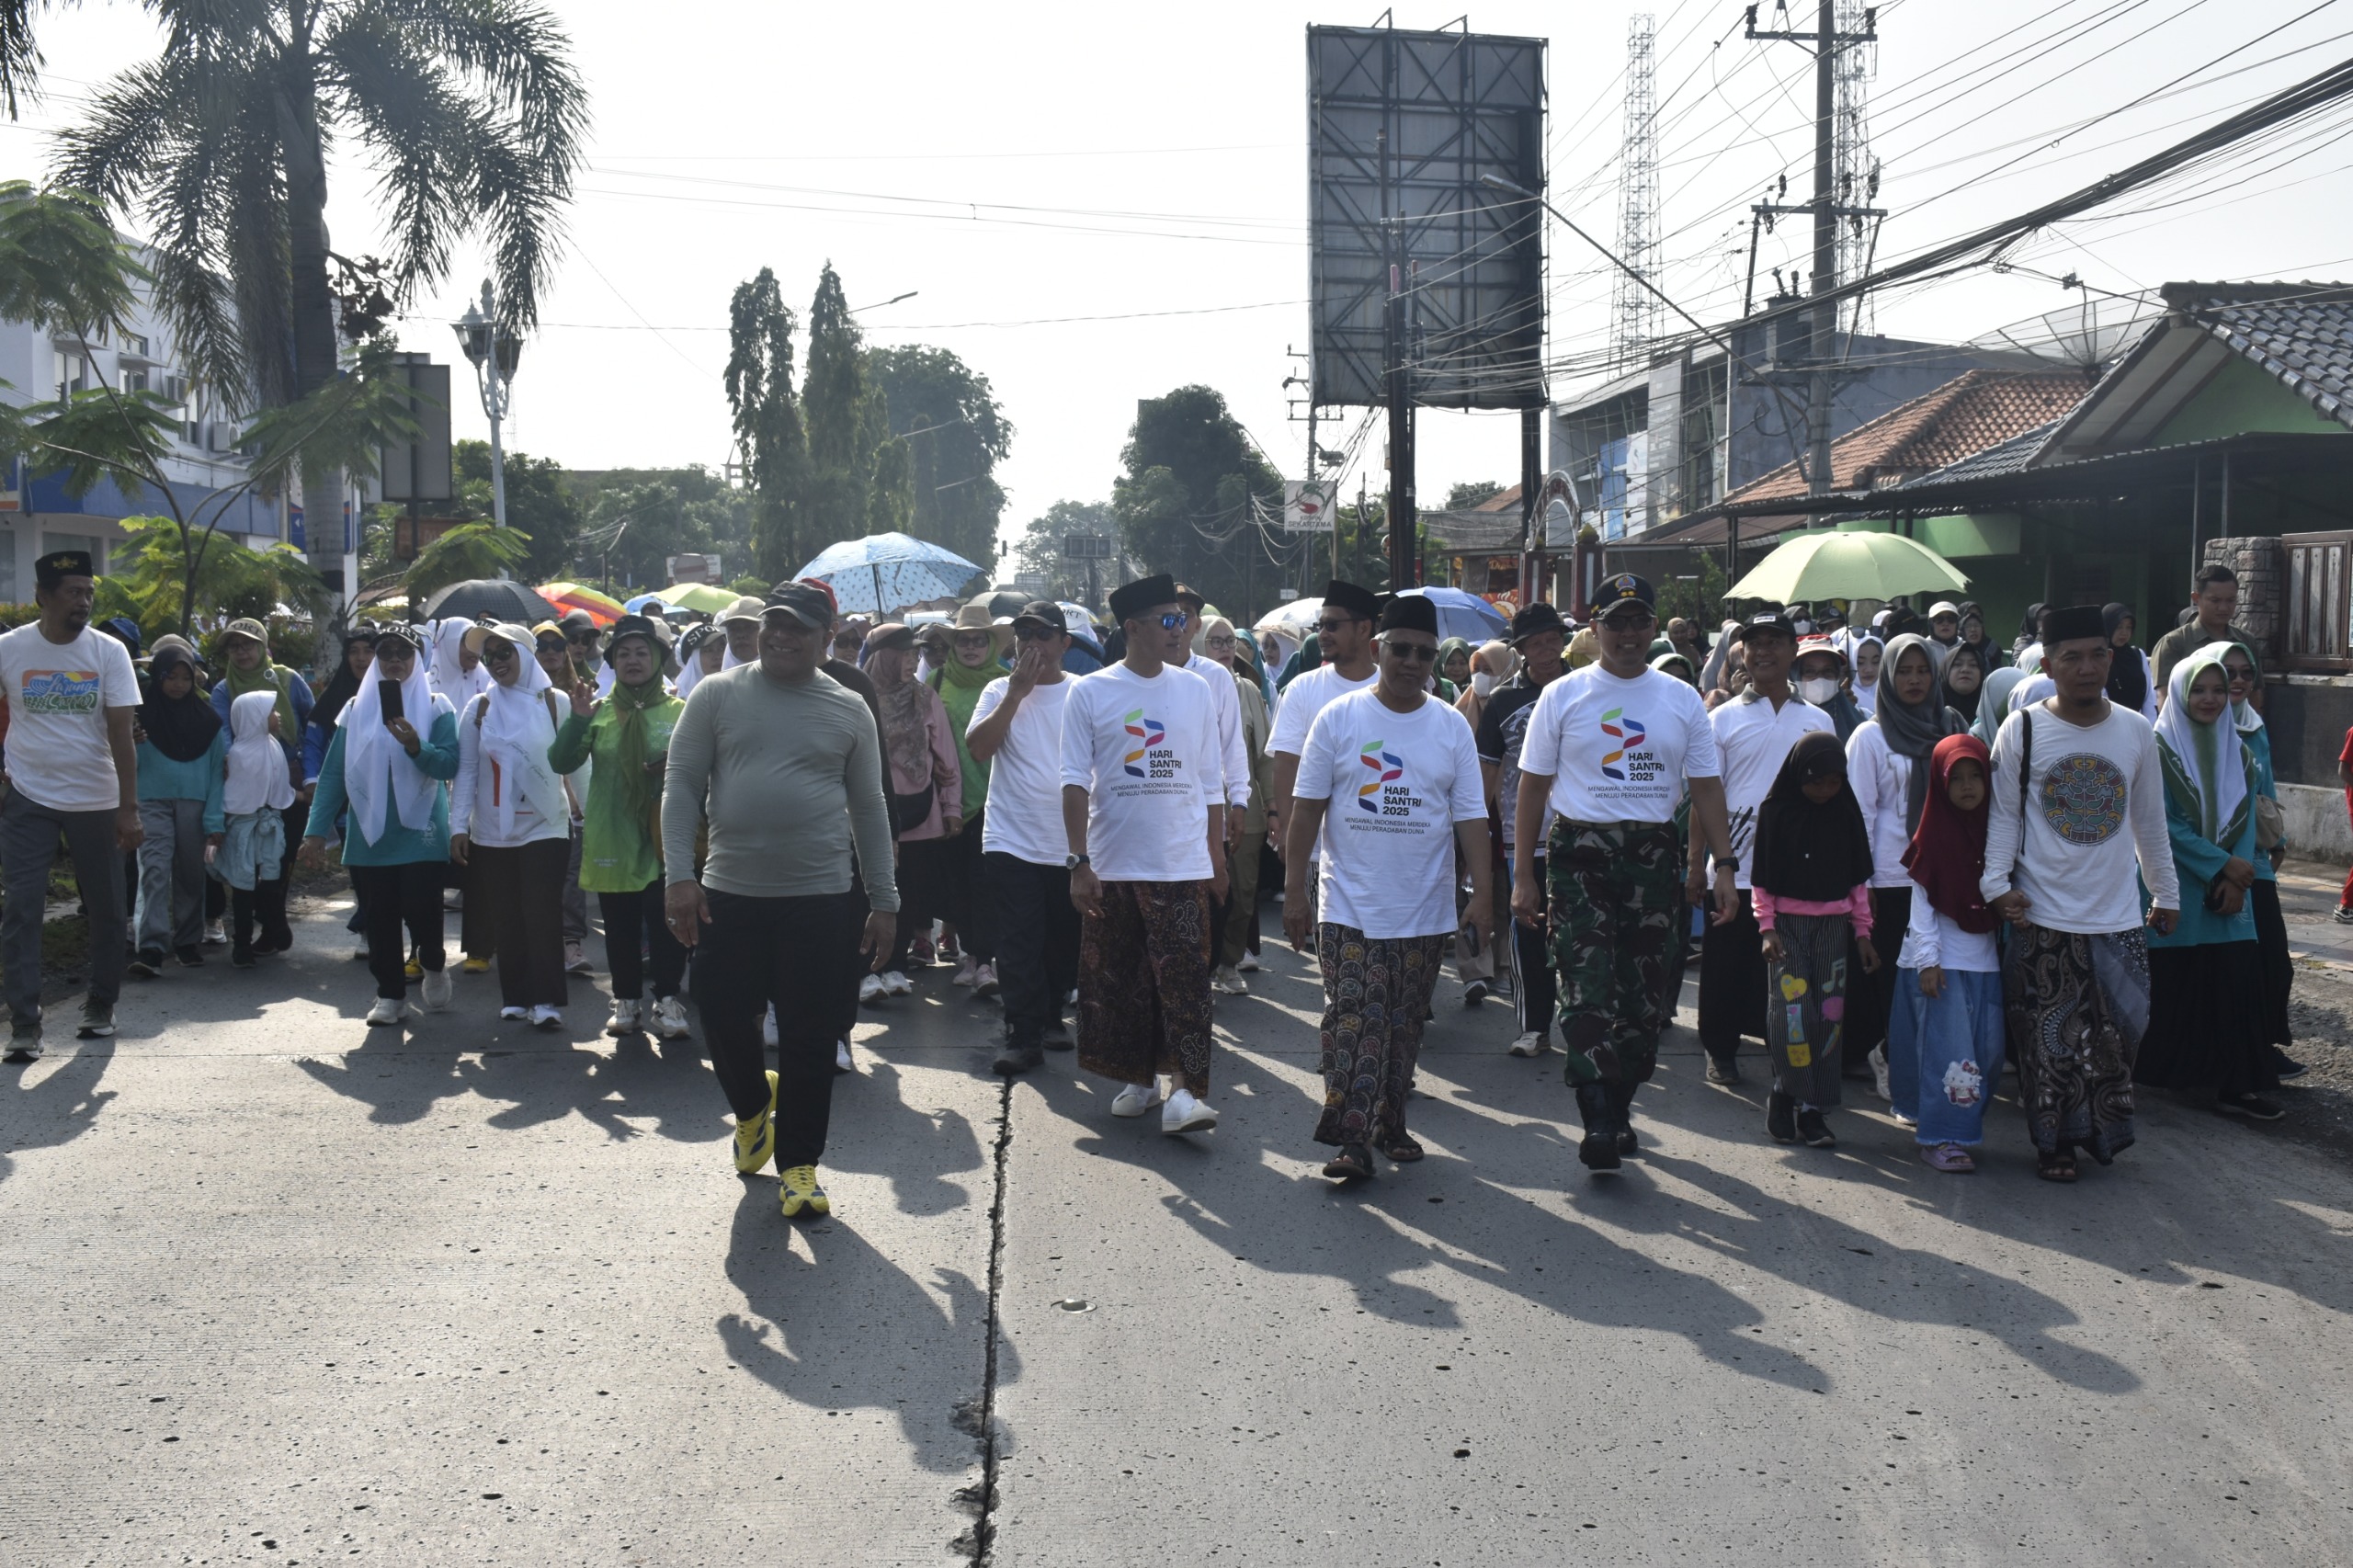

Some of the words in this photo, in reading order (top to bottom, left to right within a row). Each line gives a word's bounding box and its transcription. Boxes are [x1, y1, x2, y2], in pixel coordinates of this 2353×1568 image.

[1149, 750, 1173, 759] HARI
[1628, 753, 1654, 761] HARI
[1149, 759, 1182, 769] SANTRI
[1629, 762, 1665, 772] SANTRI
[1149, 769, 1174, 778] 2025
[1630, 772, 1654, 781] 2025
[1110, 783, 1142, 791] MENGAWAL
[1384, 786, 1410, 796] HARI
[1116, 790, 1140, 798] MENUJU
[1383, 796, 1422, 807] SANTRI
[1382, 806, 1410, 816] 2025
[1345, 816, 1374, 824] MENGAWAL
[1374, 819, 1406, 827] INDONESIA
[1349, 824, 1371, 832] MENUJU
[1371, 825, 1407, 835] PERADABAN
